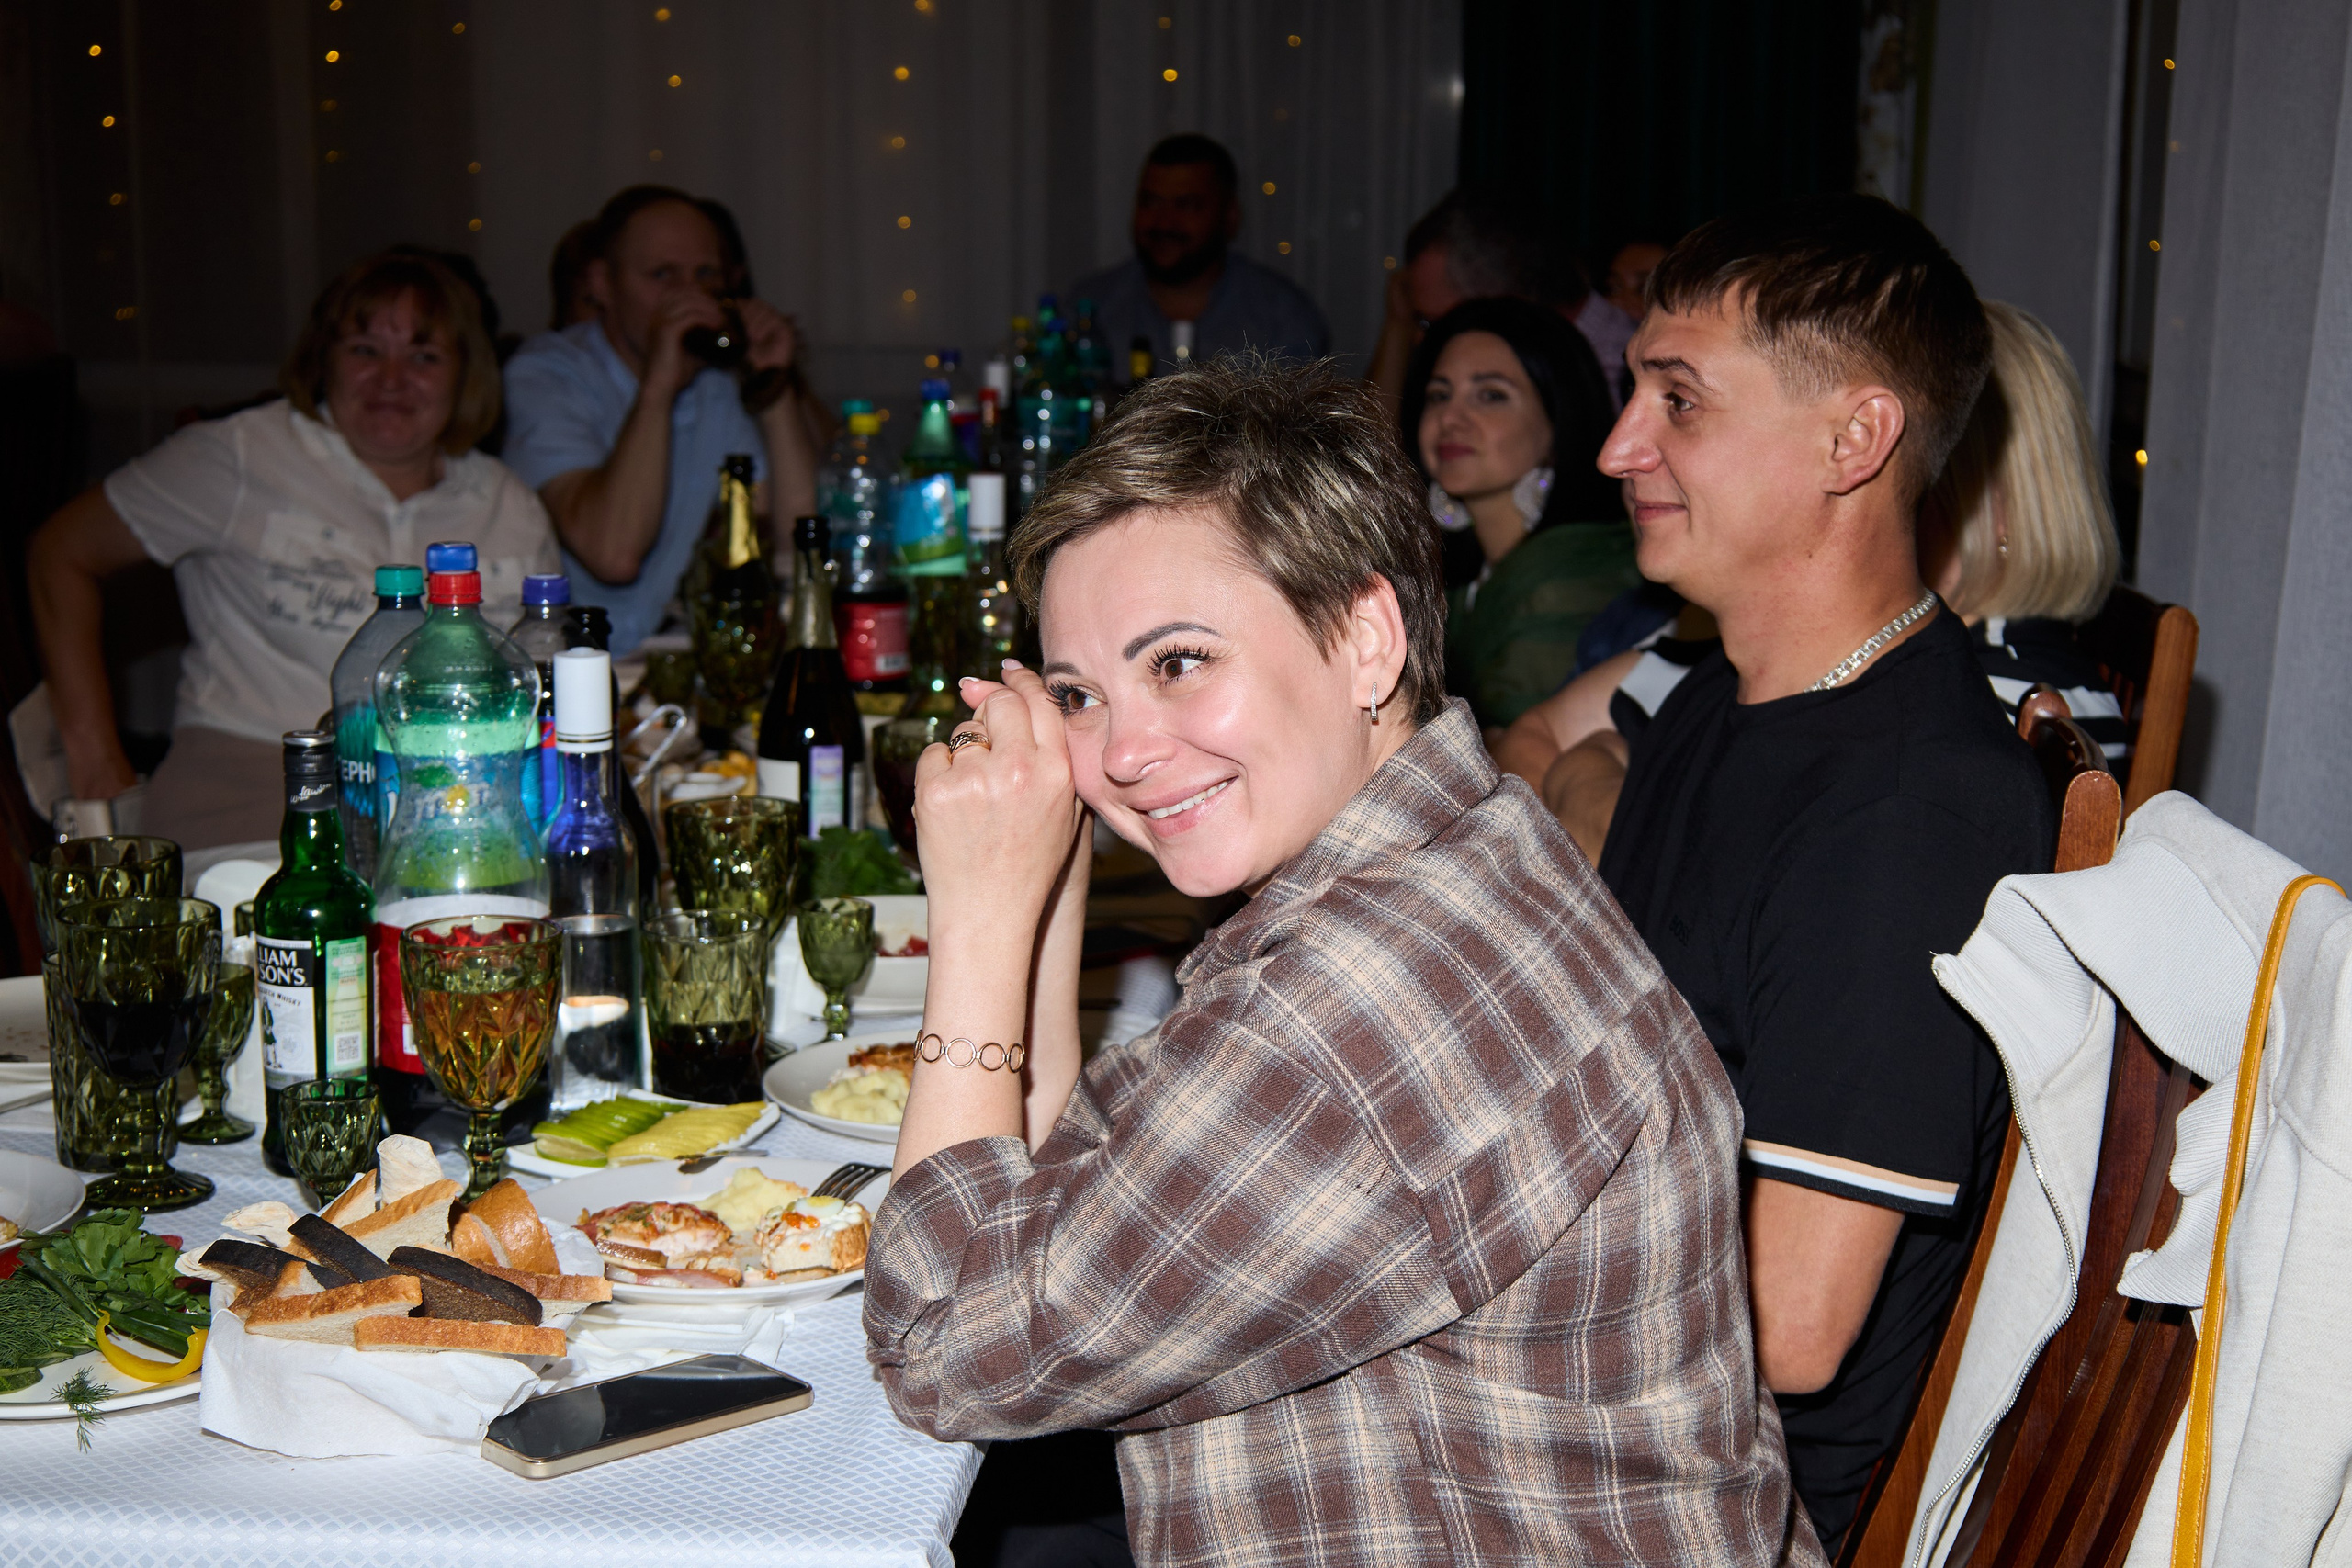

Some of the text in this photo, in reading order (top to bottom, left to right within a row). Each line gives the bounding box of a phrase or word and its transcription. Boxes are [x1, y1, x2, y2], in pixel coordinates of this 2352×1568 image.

[337, 755, 377, 784] ЕРН
[258, 964, 306, 986] SON'S
[277, 993, 301, 1006] WHISKY
